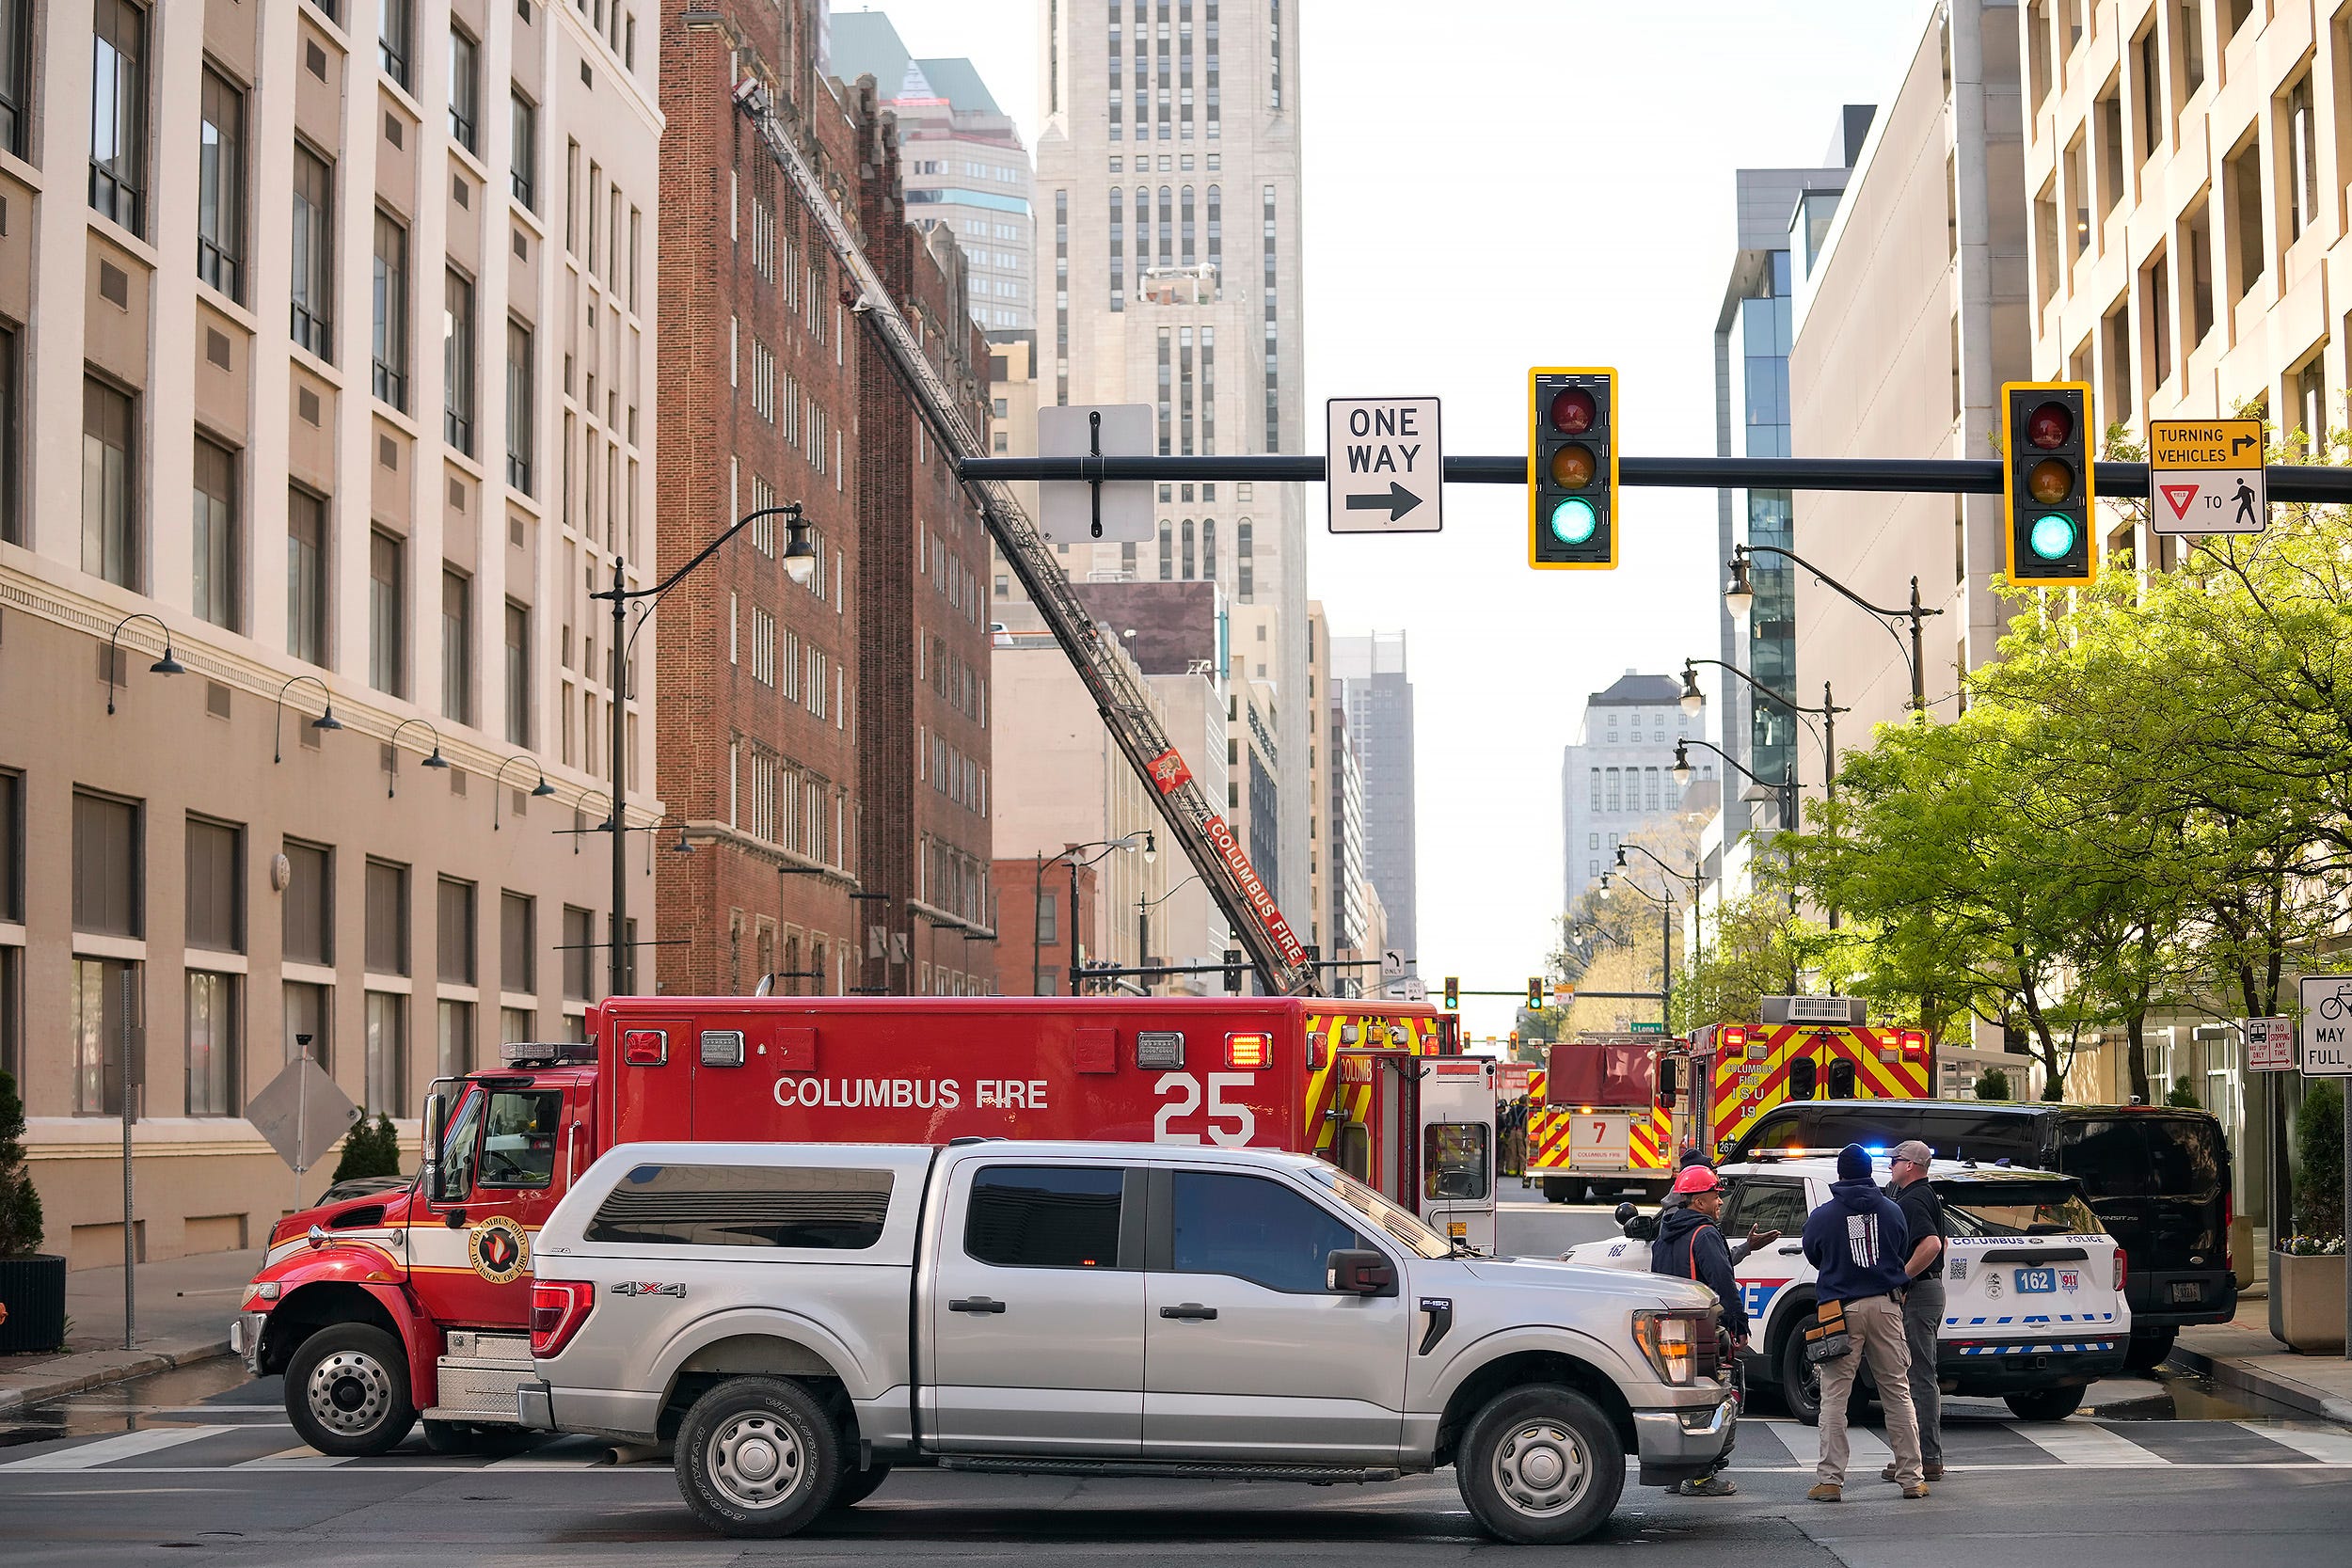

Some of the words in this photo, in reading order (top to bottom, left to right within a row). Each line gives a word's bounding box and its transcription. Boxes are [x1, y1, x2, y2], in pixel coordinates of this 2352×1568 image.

[1350, 407, 1419, 436] ONE
[2159, 429, 2223, 442] TURNING
[1347, 444, 1422, 473] WAY
[2158, 450, 2226, 462] VEHICLES
[2204, 496, 2222, 509] TO
[1211, 823, 1276, 917] COLUMBUS
[1271, 920, 1303, 960] FIRE
[2275, 1023, 2284, 1032] NO
[2316, 1027, 2345, 1042] MAY
[2309, 1050, 2344, 1065] FULL
[1724, 1064, 1774, 1073] COLUMBUS
[1739, 1075, 1760, 1085] FIRE
[772, 1077, 961, 1109] COLUMBUS
[976, 1080, 1048, 1109] FIRE
[1154, 1072, 1255, 1148] 25
[1740, 1105, 1756, 1118] 19
[1593, 1121, 1607, 1144] 7
[471, 1217, 509, 1247] COLMBUS
[511, 1223, 526, 1245] OHIO
[2065, 1235, 2105, 1243] POLICE
[1952, 1237, 2025, 1245] COLUMBUS
[1607, 1243, 1627, 1258] 162
[471, 1253, 501, 1282] DIVISION
[503, 1273, 515, 1282] OF
[515, 1252, 527, 1274] FIRE
[2021, 1272, 2049, 1291] 162
[2062, 1275, 2076, 1286] 911
[765, 1397, 819, 1491] WRANGLER
[691, 1426, 747, 1521] GOODYEAR
